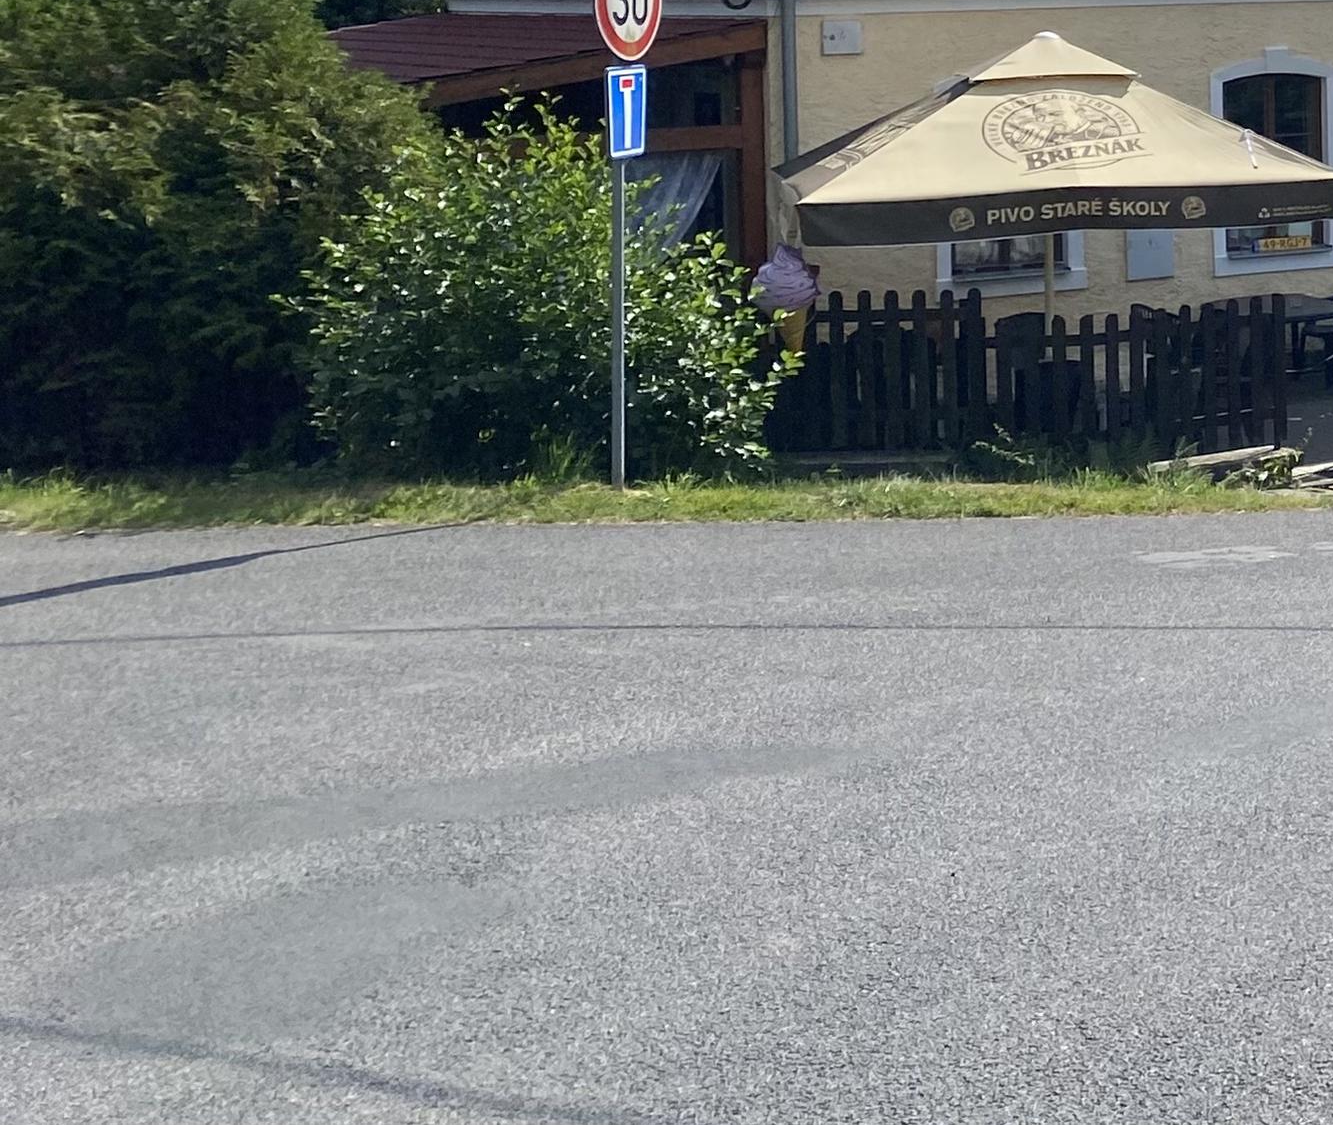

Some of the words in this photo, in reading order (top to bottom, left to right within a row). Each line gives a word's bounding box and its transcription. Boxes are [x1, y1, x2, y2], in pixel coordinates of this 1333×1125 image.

[986, 206, 1035, 225] PIVO
[1040, 198, 1103, 220] STARÉ
[1108, 197, 1171, 217] ŠKOLY
